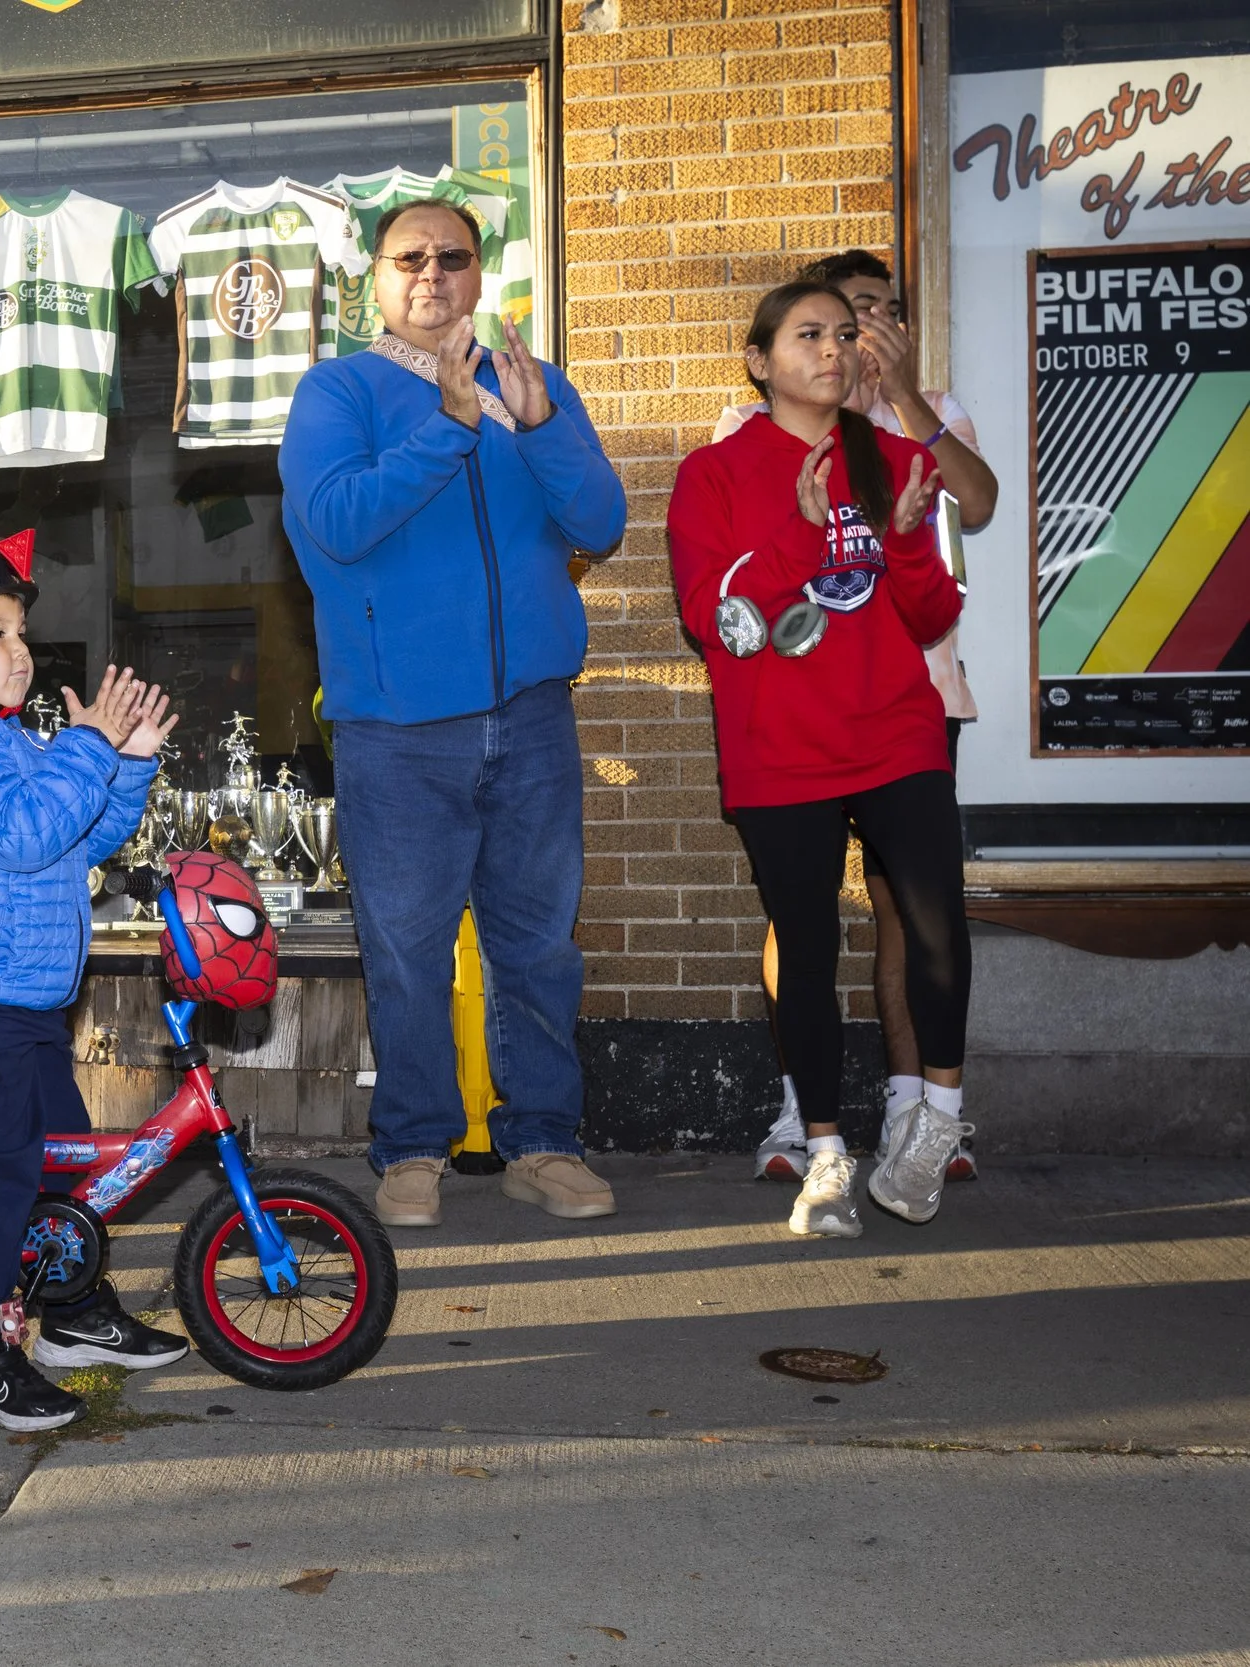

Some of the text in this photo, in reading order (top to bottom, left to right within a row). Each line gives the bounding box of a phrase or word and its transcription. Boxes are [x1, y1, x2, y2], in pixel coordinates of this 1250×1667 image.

[953, 72, 1203, 202] Theatre
[1080, 136, 1250, 240] of the
[45, 283, 94, 303] Becker
[1036, 263, 1244, 303] BUFFALO
[36, 295, 88, 316] Bourne
[1036, 297, 1250, 336] FILM FES
[1036, 343, 1149, 373] OCTOBER
[1175, 341, 1191, 365] 9
